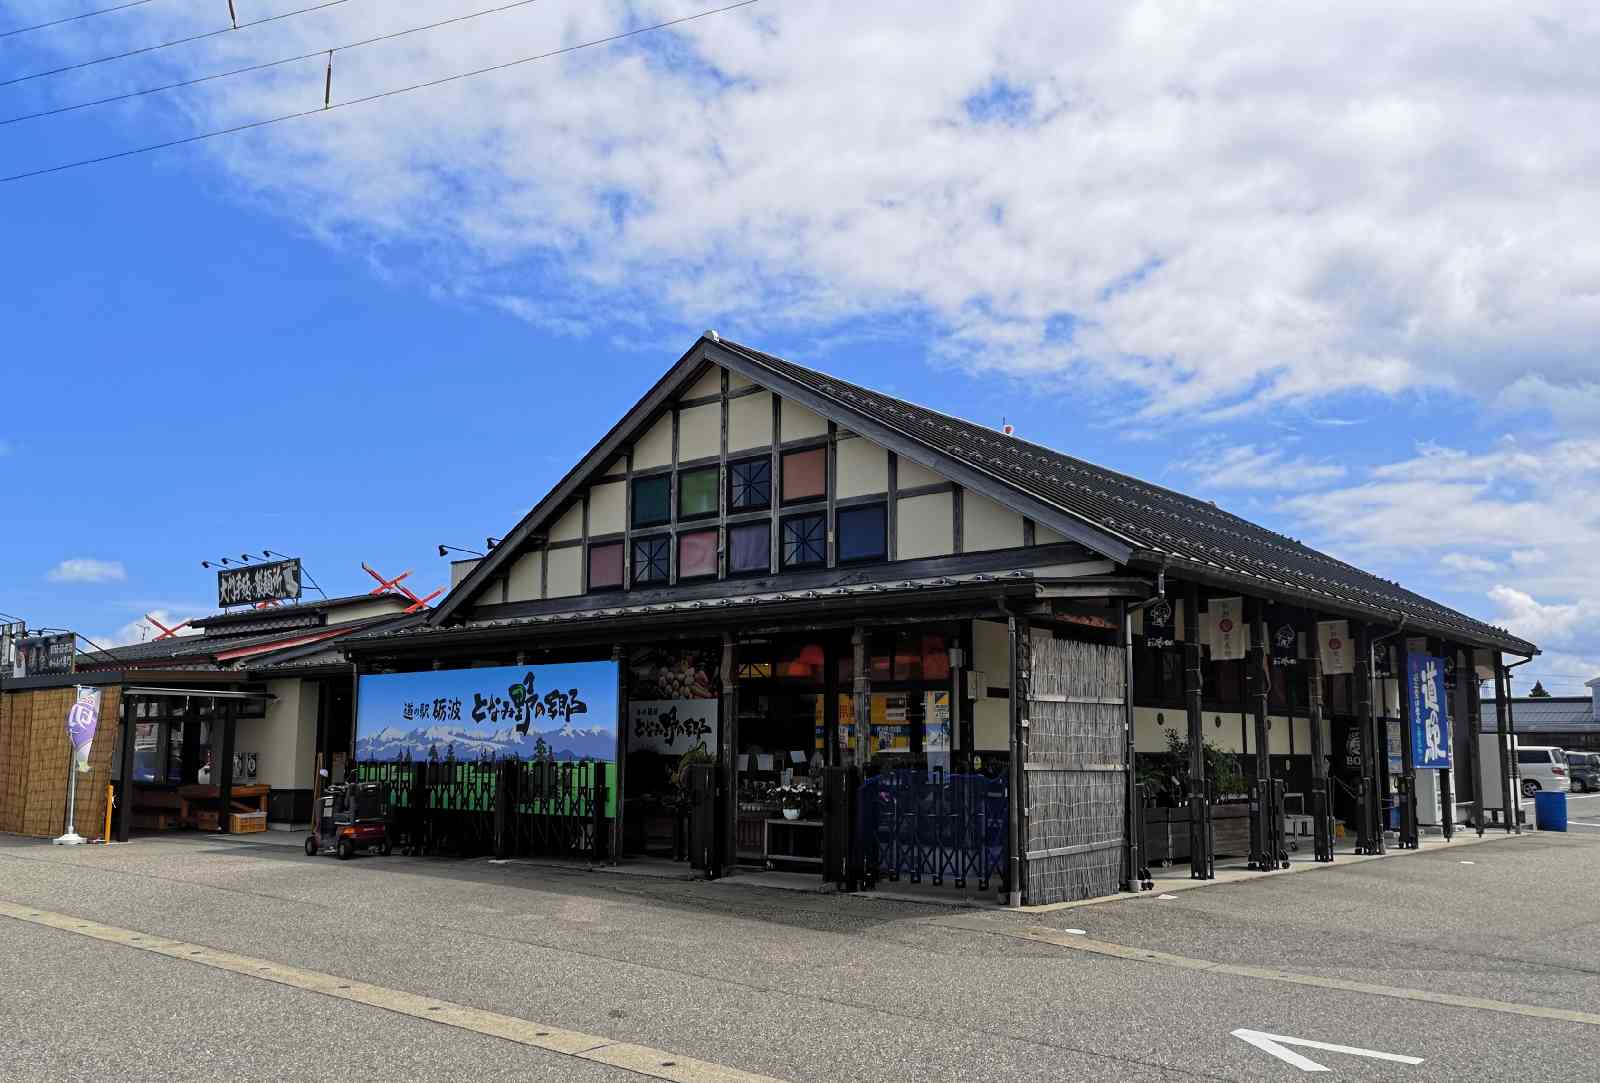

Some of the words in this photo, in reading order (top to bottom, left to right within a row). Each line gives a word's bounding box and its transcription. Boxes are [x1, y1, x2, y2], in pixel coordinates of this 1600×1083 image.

[402, 701, 431, 721] 道の駅
[432, 696, 462, 721] 砺波
[471, 671, 588, 736] となみ野の郷
[1421, 660, 1447, 765] 道の駅
